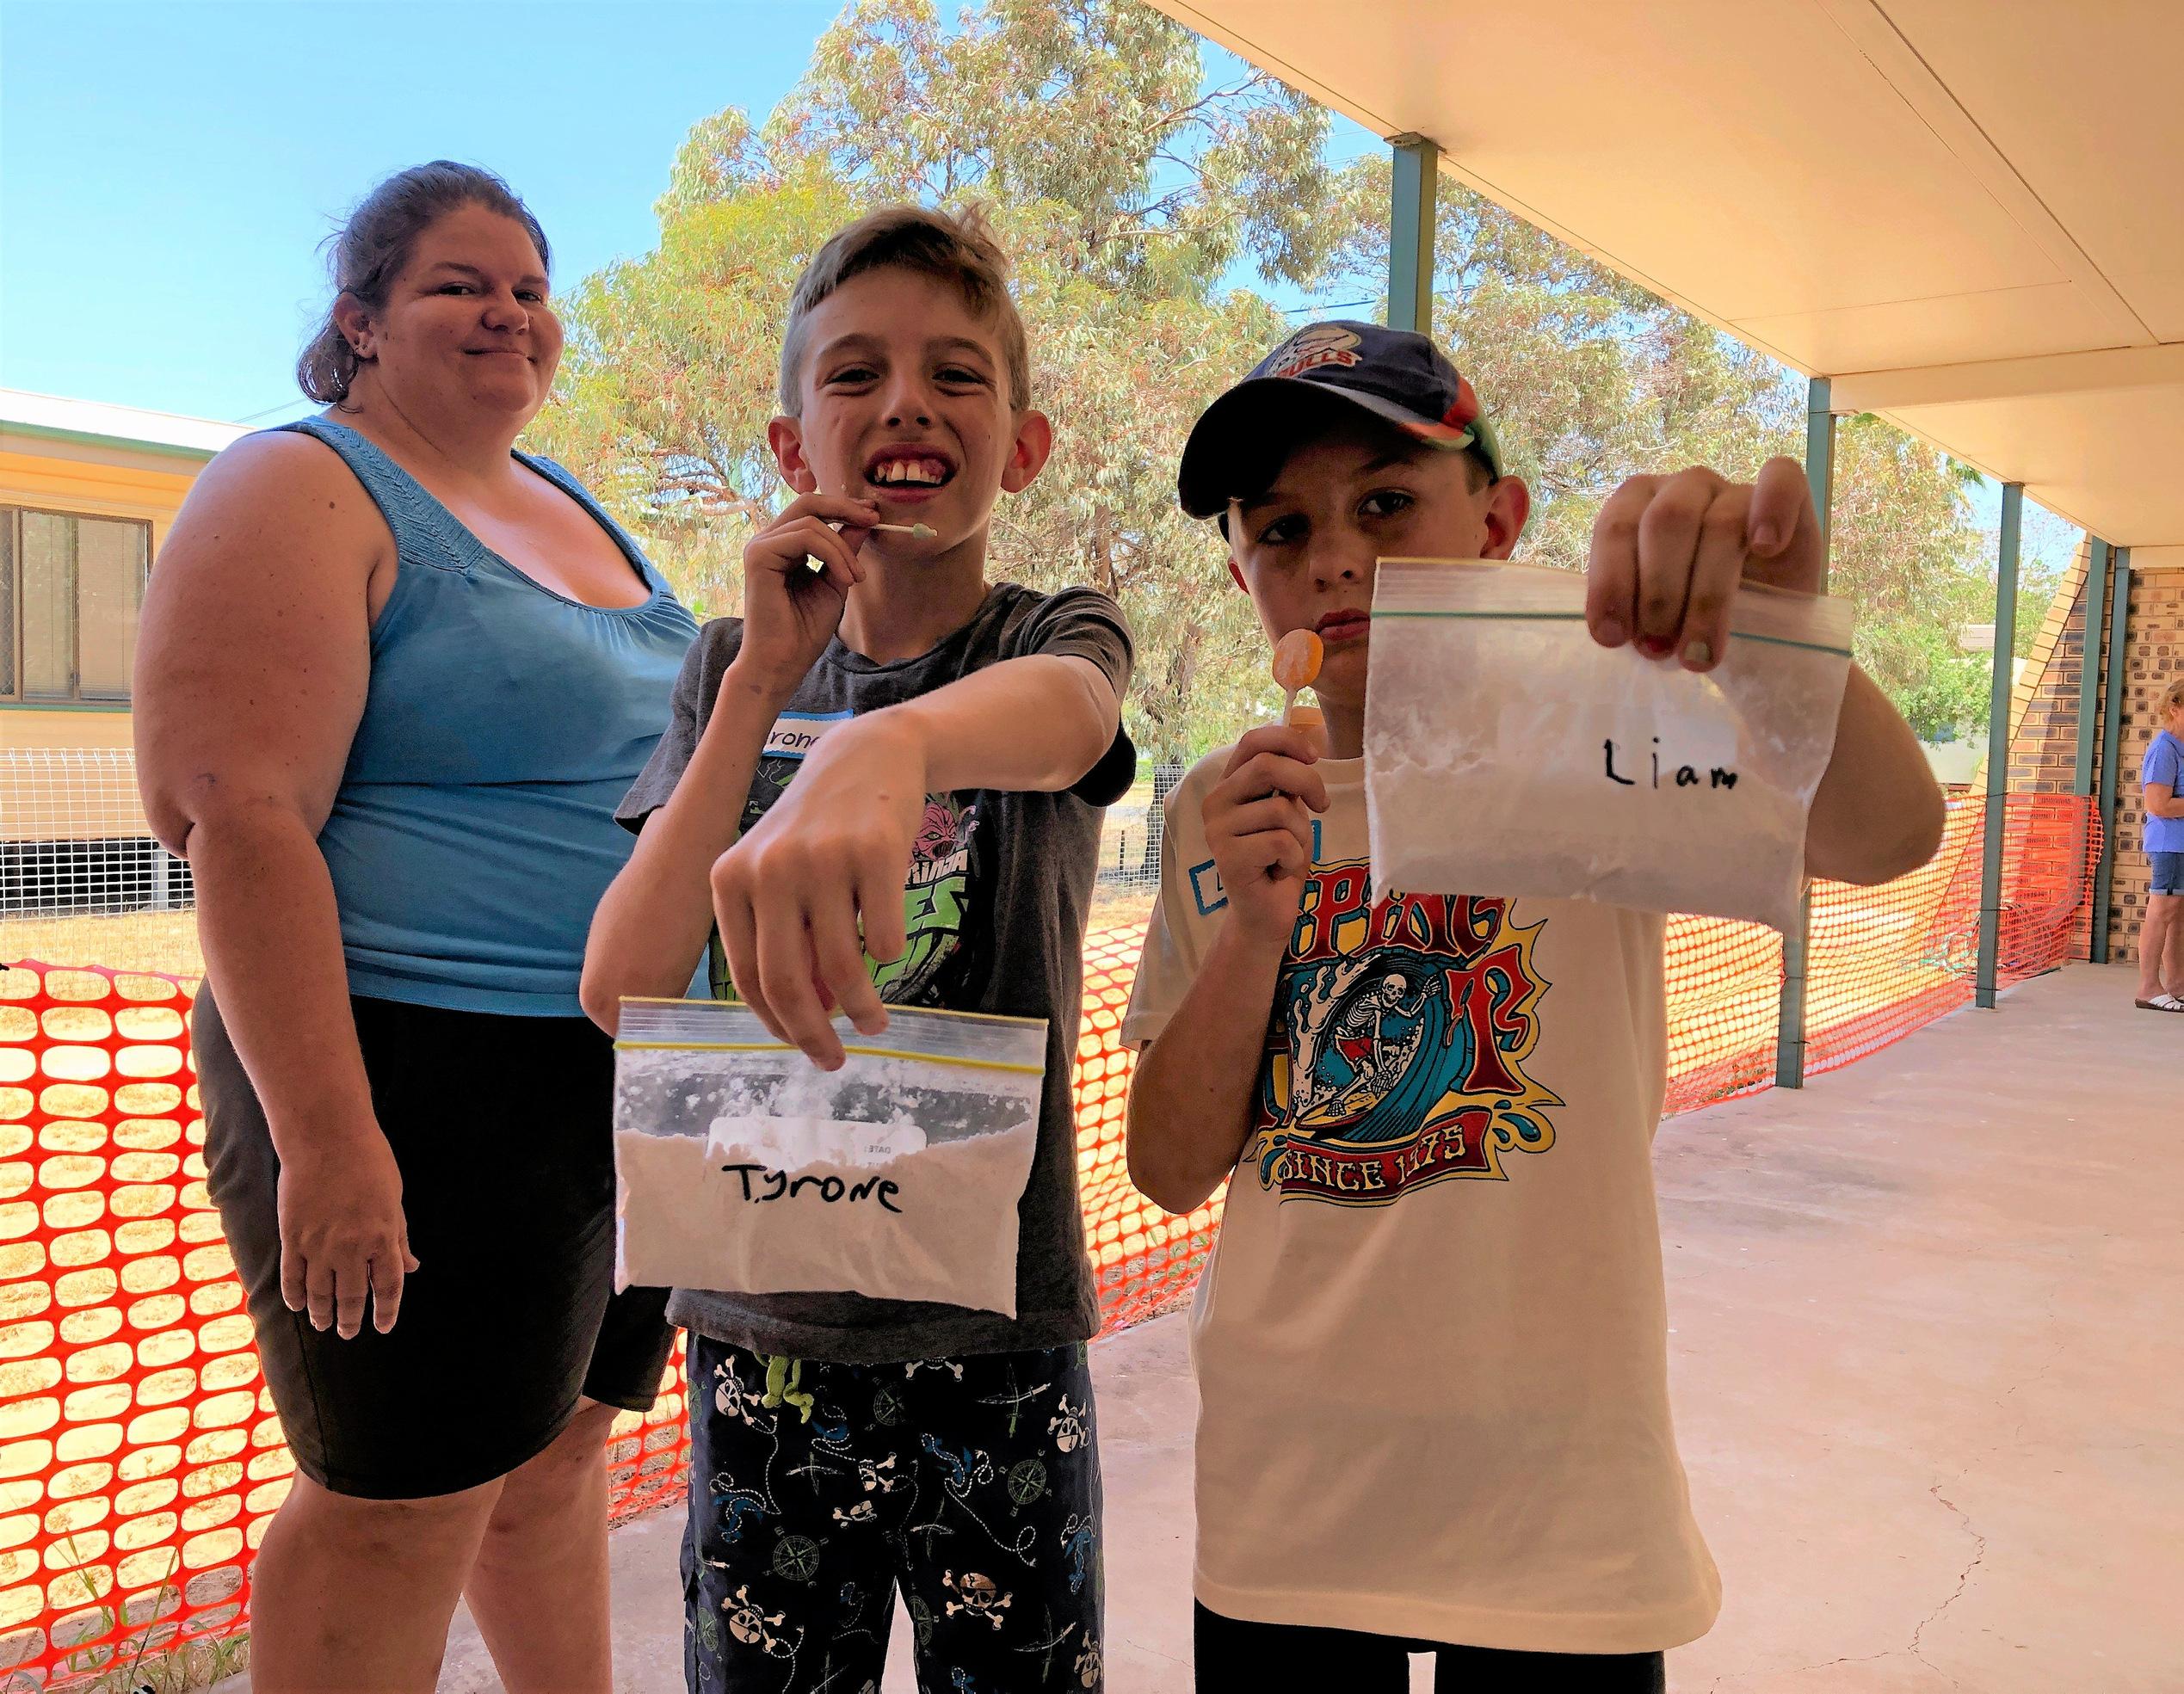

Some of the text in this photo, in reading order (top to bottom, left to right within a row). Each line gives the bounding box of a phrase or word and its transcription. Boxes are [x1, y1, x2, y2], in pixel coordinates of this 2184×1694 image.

[1604, 736, 1739, 790] Liam
[1397, 1124, 1465, 1186] 1975
[721, 1163, 904, 1214] Tyrone
